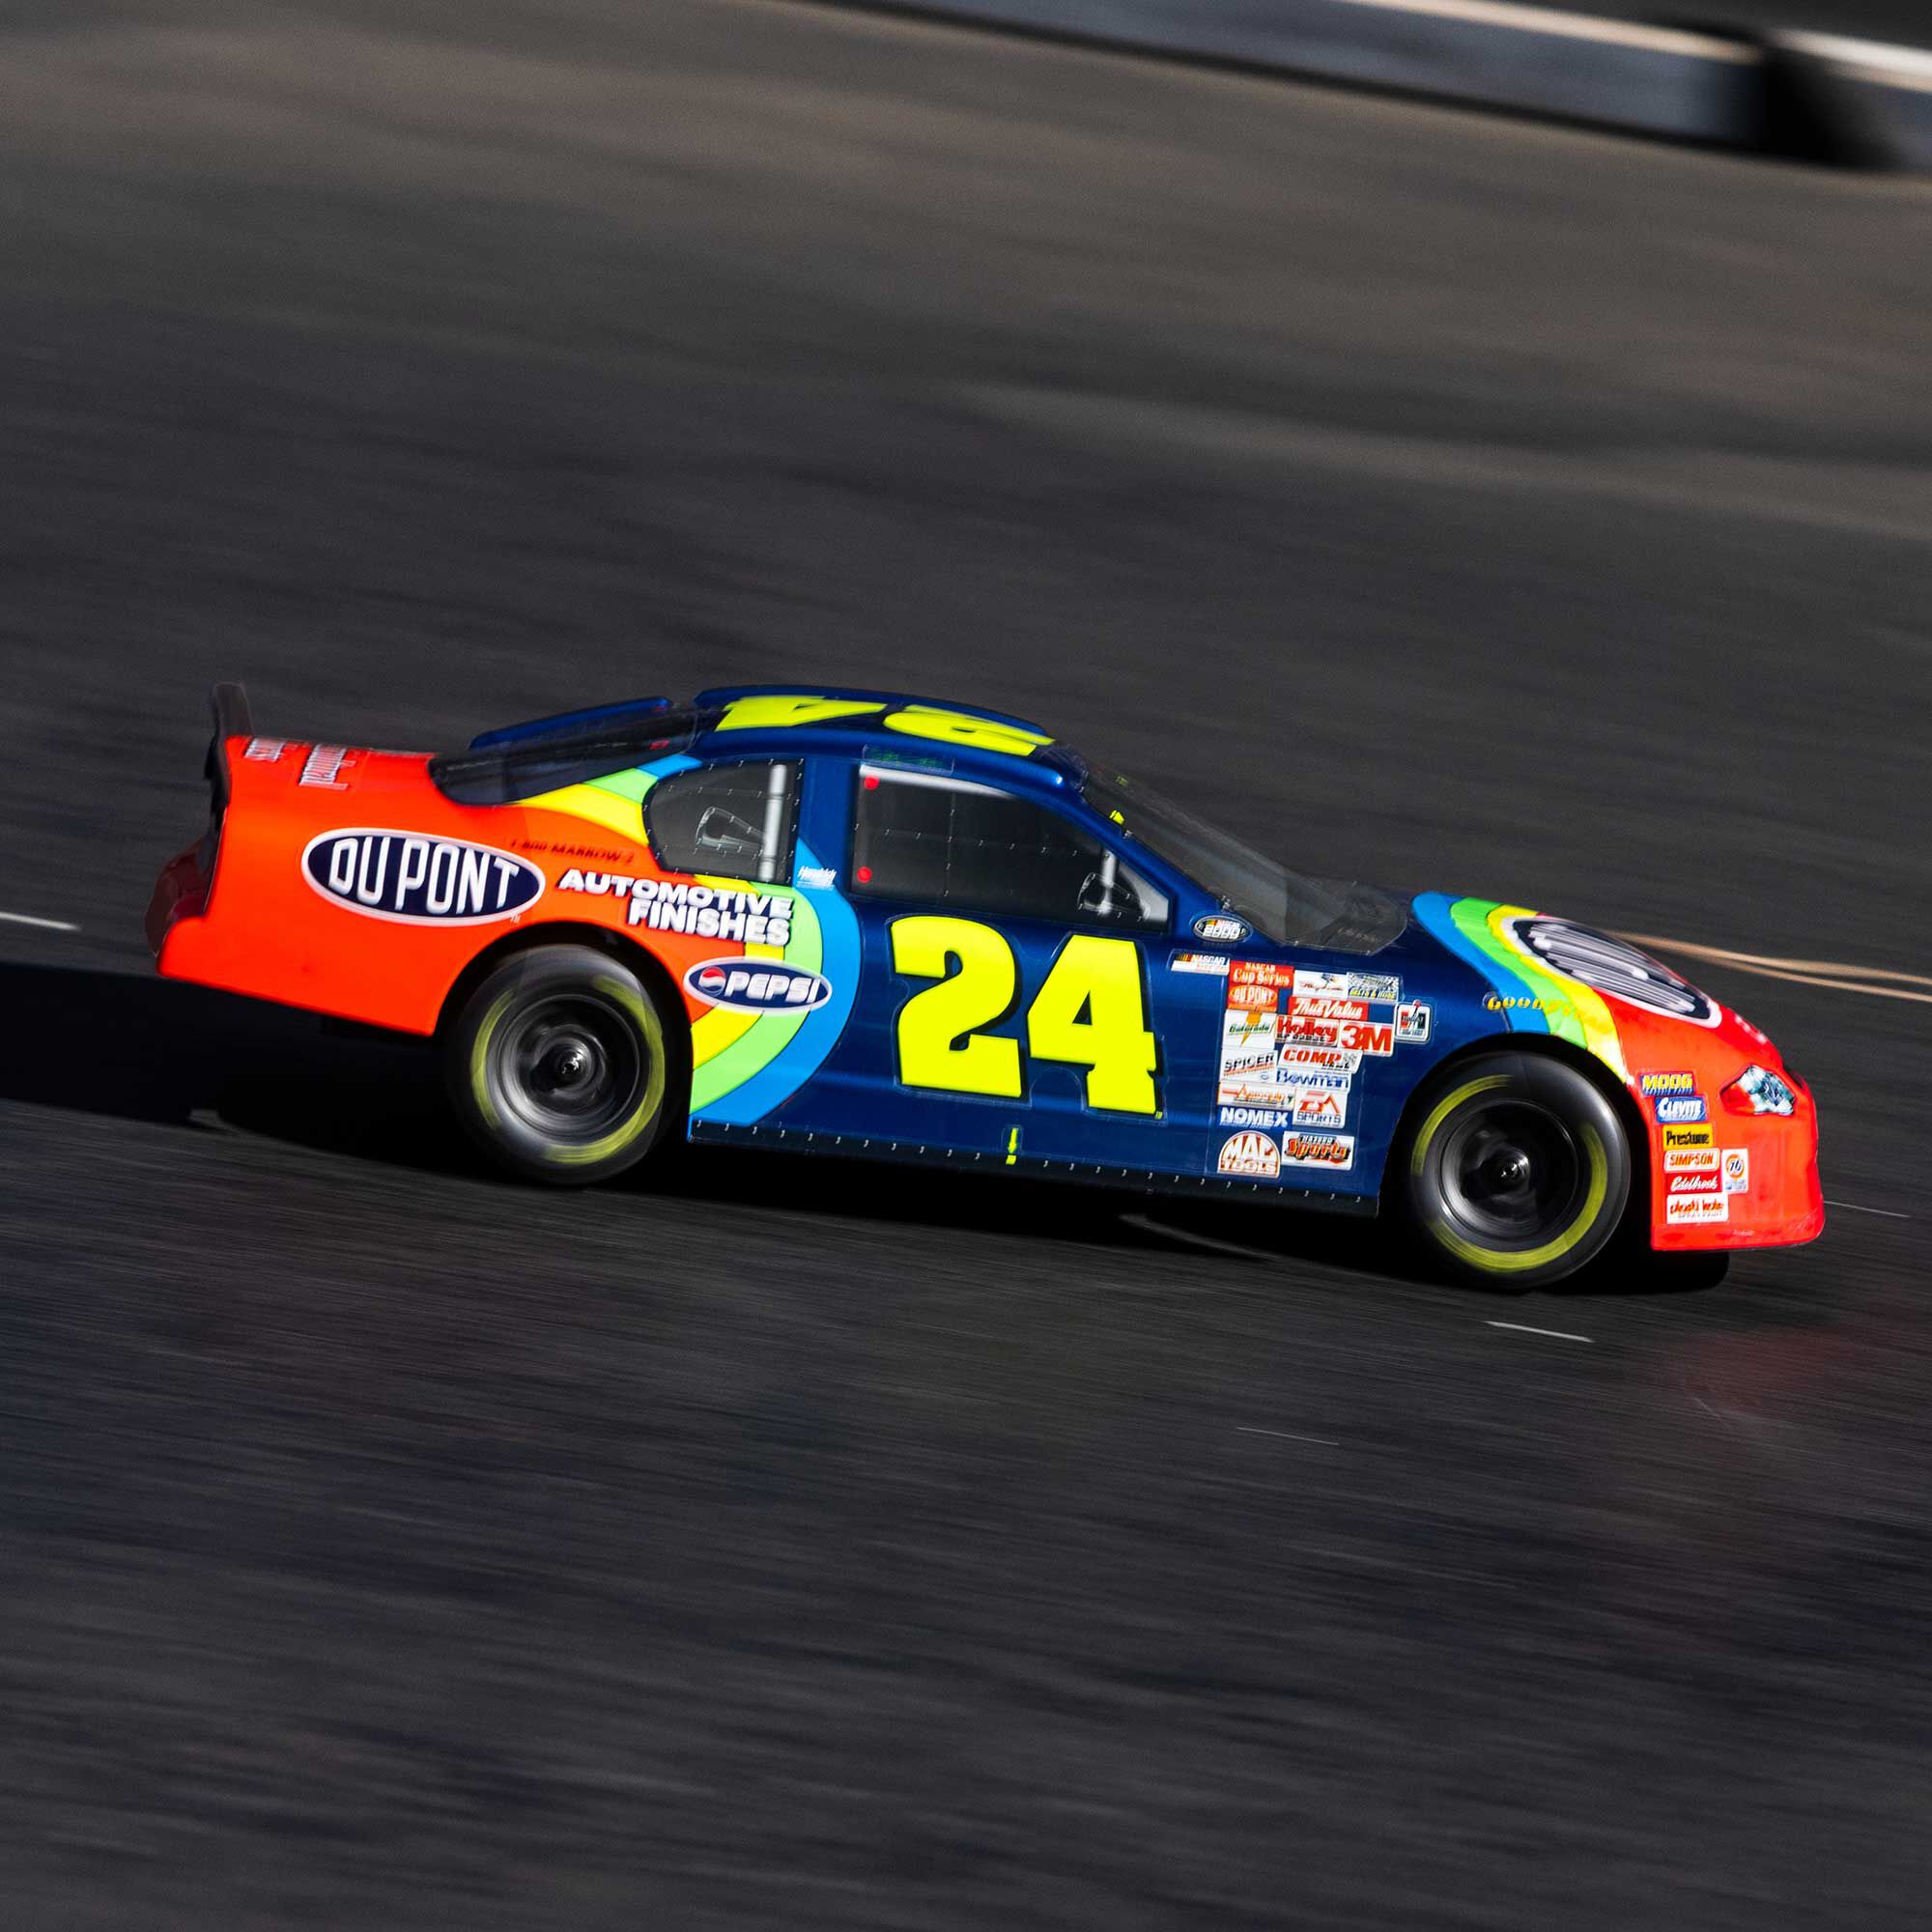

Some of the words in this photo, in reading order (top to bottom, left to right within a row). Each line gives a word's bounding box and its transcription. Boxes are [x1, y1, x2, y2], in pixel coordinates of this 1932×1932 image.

[558, 869, 794, 921] AUTOMOTIVE
[628, 898, 790, 947] FINISHES
[1203, 924, 1241, 940] 2000
[1190, 953, 1226, 966] NASCAR
[1245, 962, 1276, 972] NASCAR
[1233, 969, 1256, 983] Cup
[1257, 971, 1291, 986] Series
[724, 971, 820, 1004] PEPSI
[891, 916, 1157, 1115] 24
[1292, 998, 1323, 1017] True
[1323, 1001, 1364, 1021] Value
[1276, 1015, 1338, 1042] Holley
[1341, 1024, 1392, 1052] 3M
[1224, 1053, 1274, 1072] SPICER
[1283, 1048, 1342, 1065] COMP
[1643, 1074, 1693, 1090] MOOG
[1220, 1107, 1288, 1127] NOMEX
[1296, 1111, 1341, 1124] SPORTS
[1224, 1133, 1275, 1160] MAC
[1670, 1152, 1714, 1166] SIMPSON
